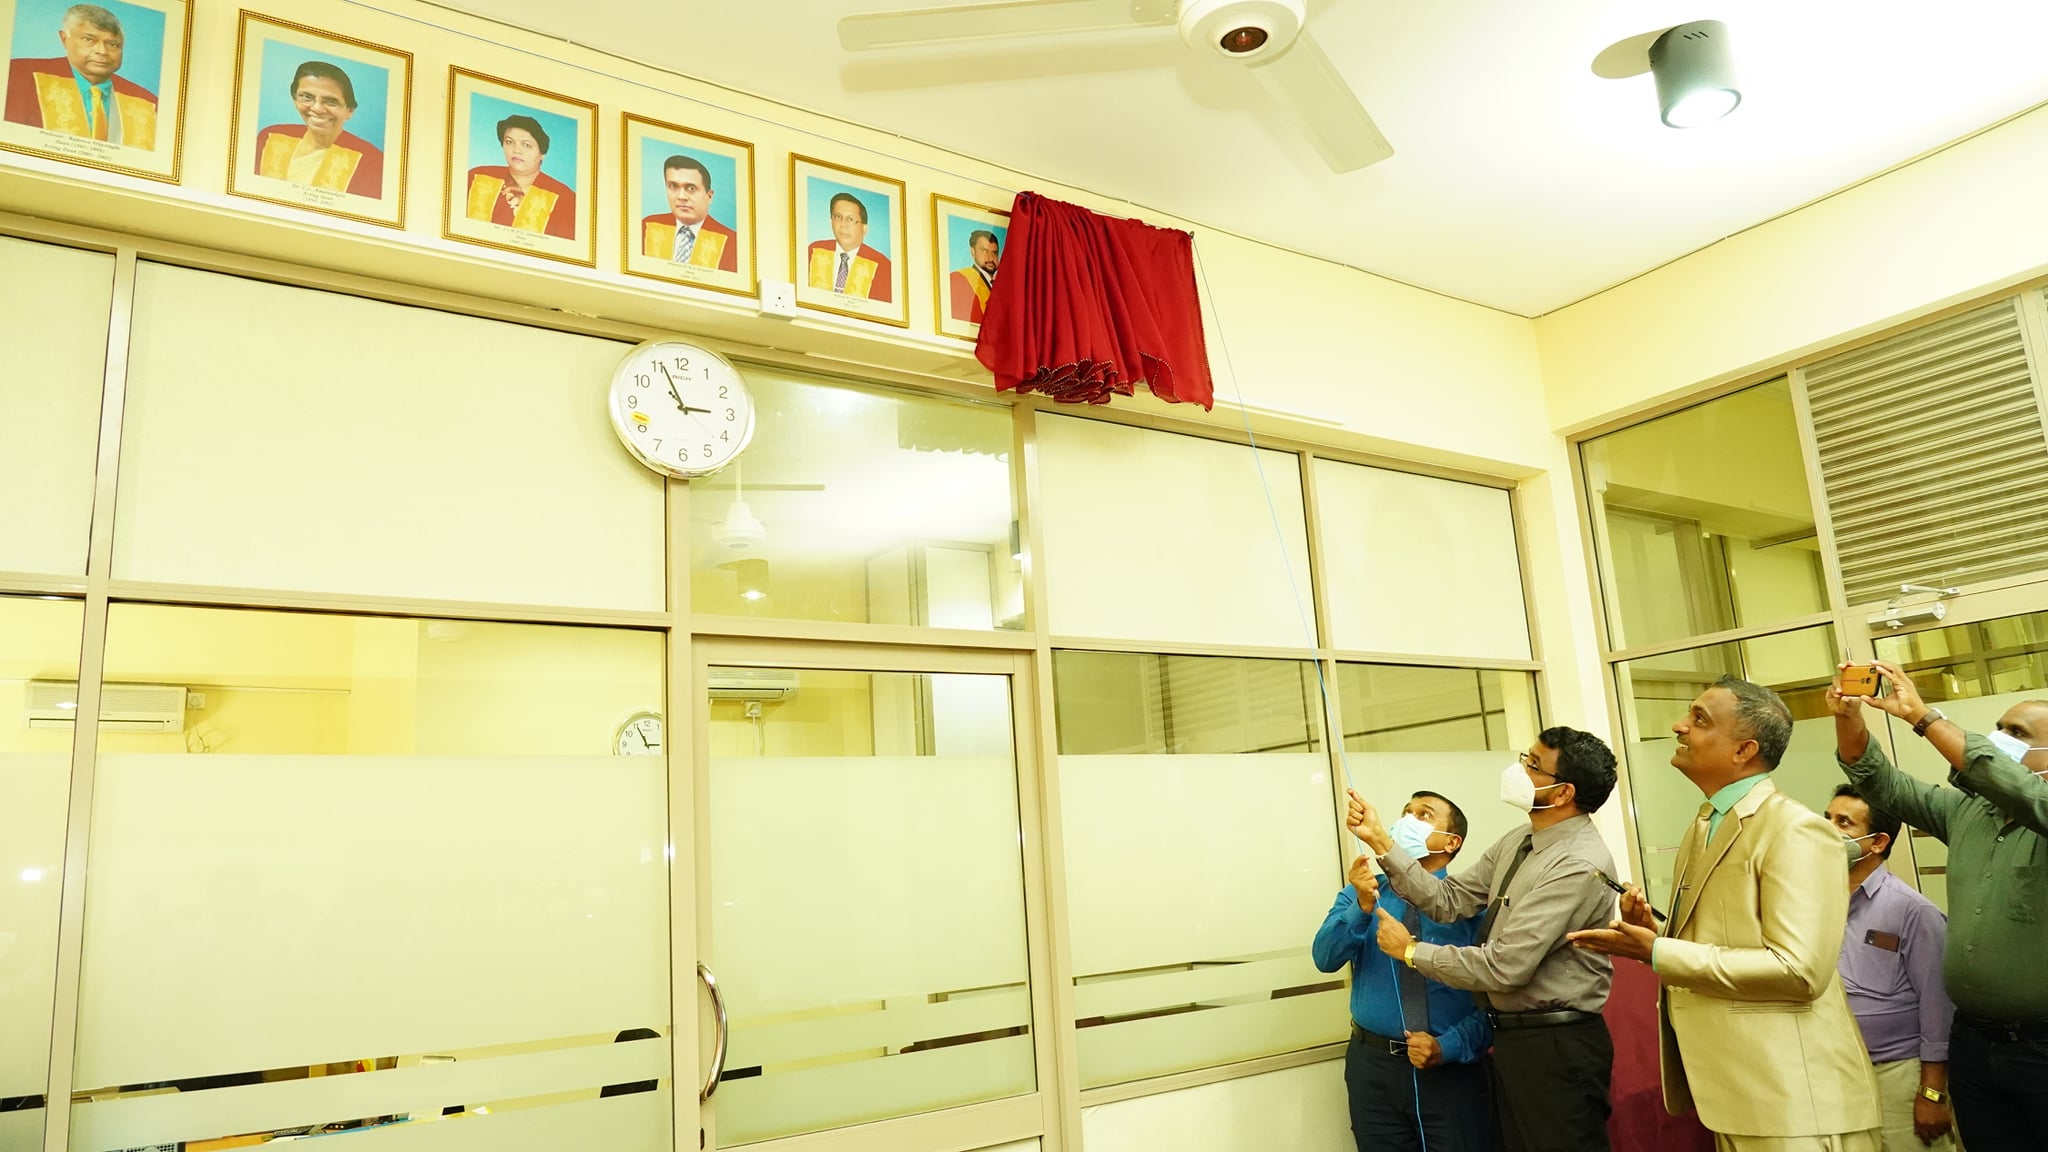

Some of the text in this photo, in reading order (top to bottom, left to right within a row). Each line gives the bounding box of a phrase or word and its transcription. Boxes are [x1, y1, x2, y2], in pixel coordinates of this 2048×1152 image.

[651, 360, 664, 373] 11
[674, 357, 689, 371] 12
[704, 367, 709, 380] 1
[633, 374, 650, 388] 10
[718, 385, 728, 399] 2
[627, 395, 638, 409] 9
[725, 408, 736, 421] 3
[720, 430, 729, 442] 4
[653, 438, 662, 451] 7
[703, 444, 713, 457] 5
[678, 448, 688, 462] 6
